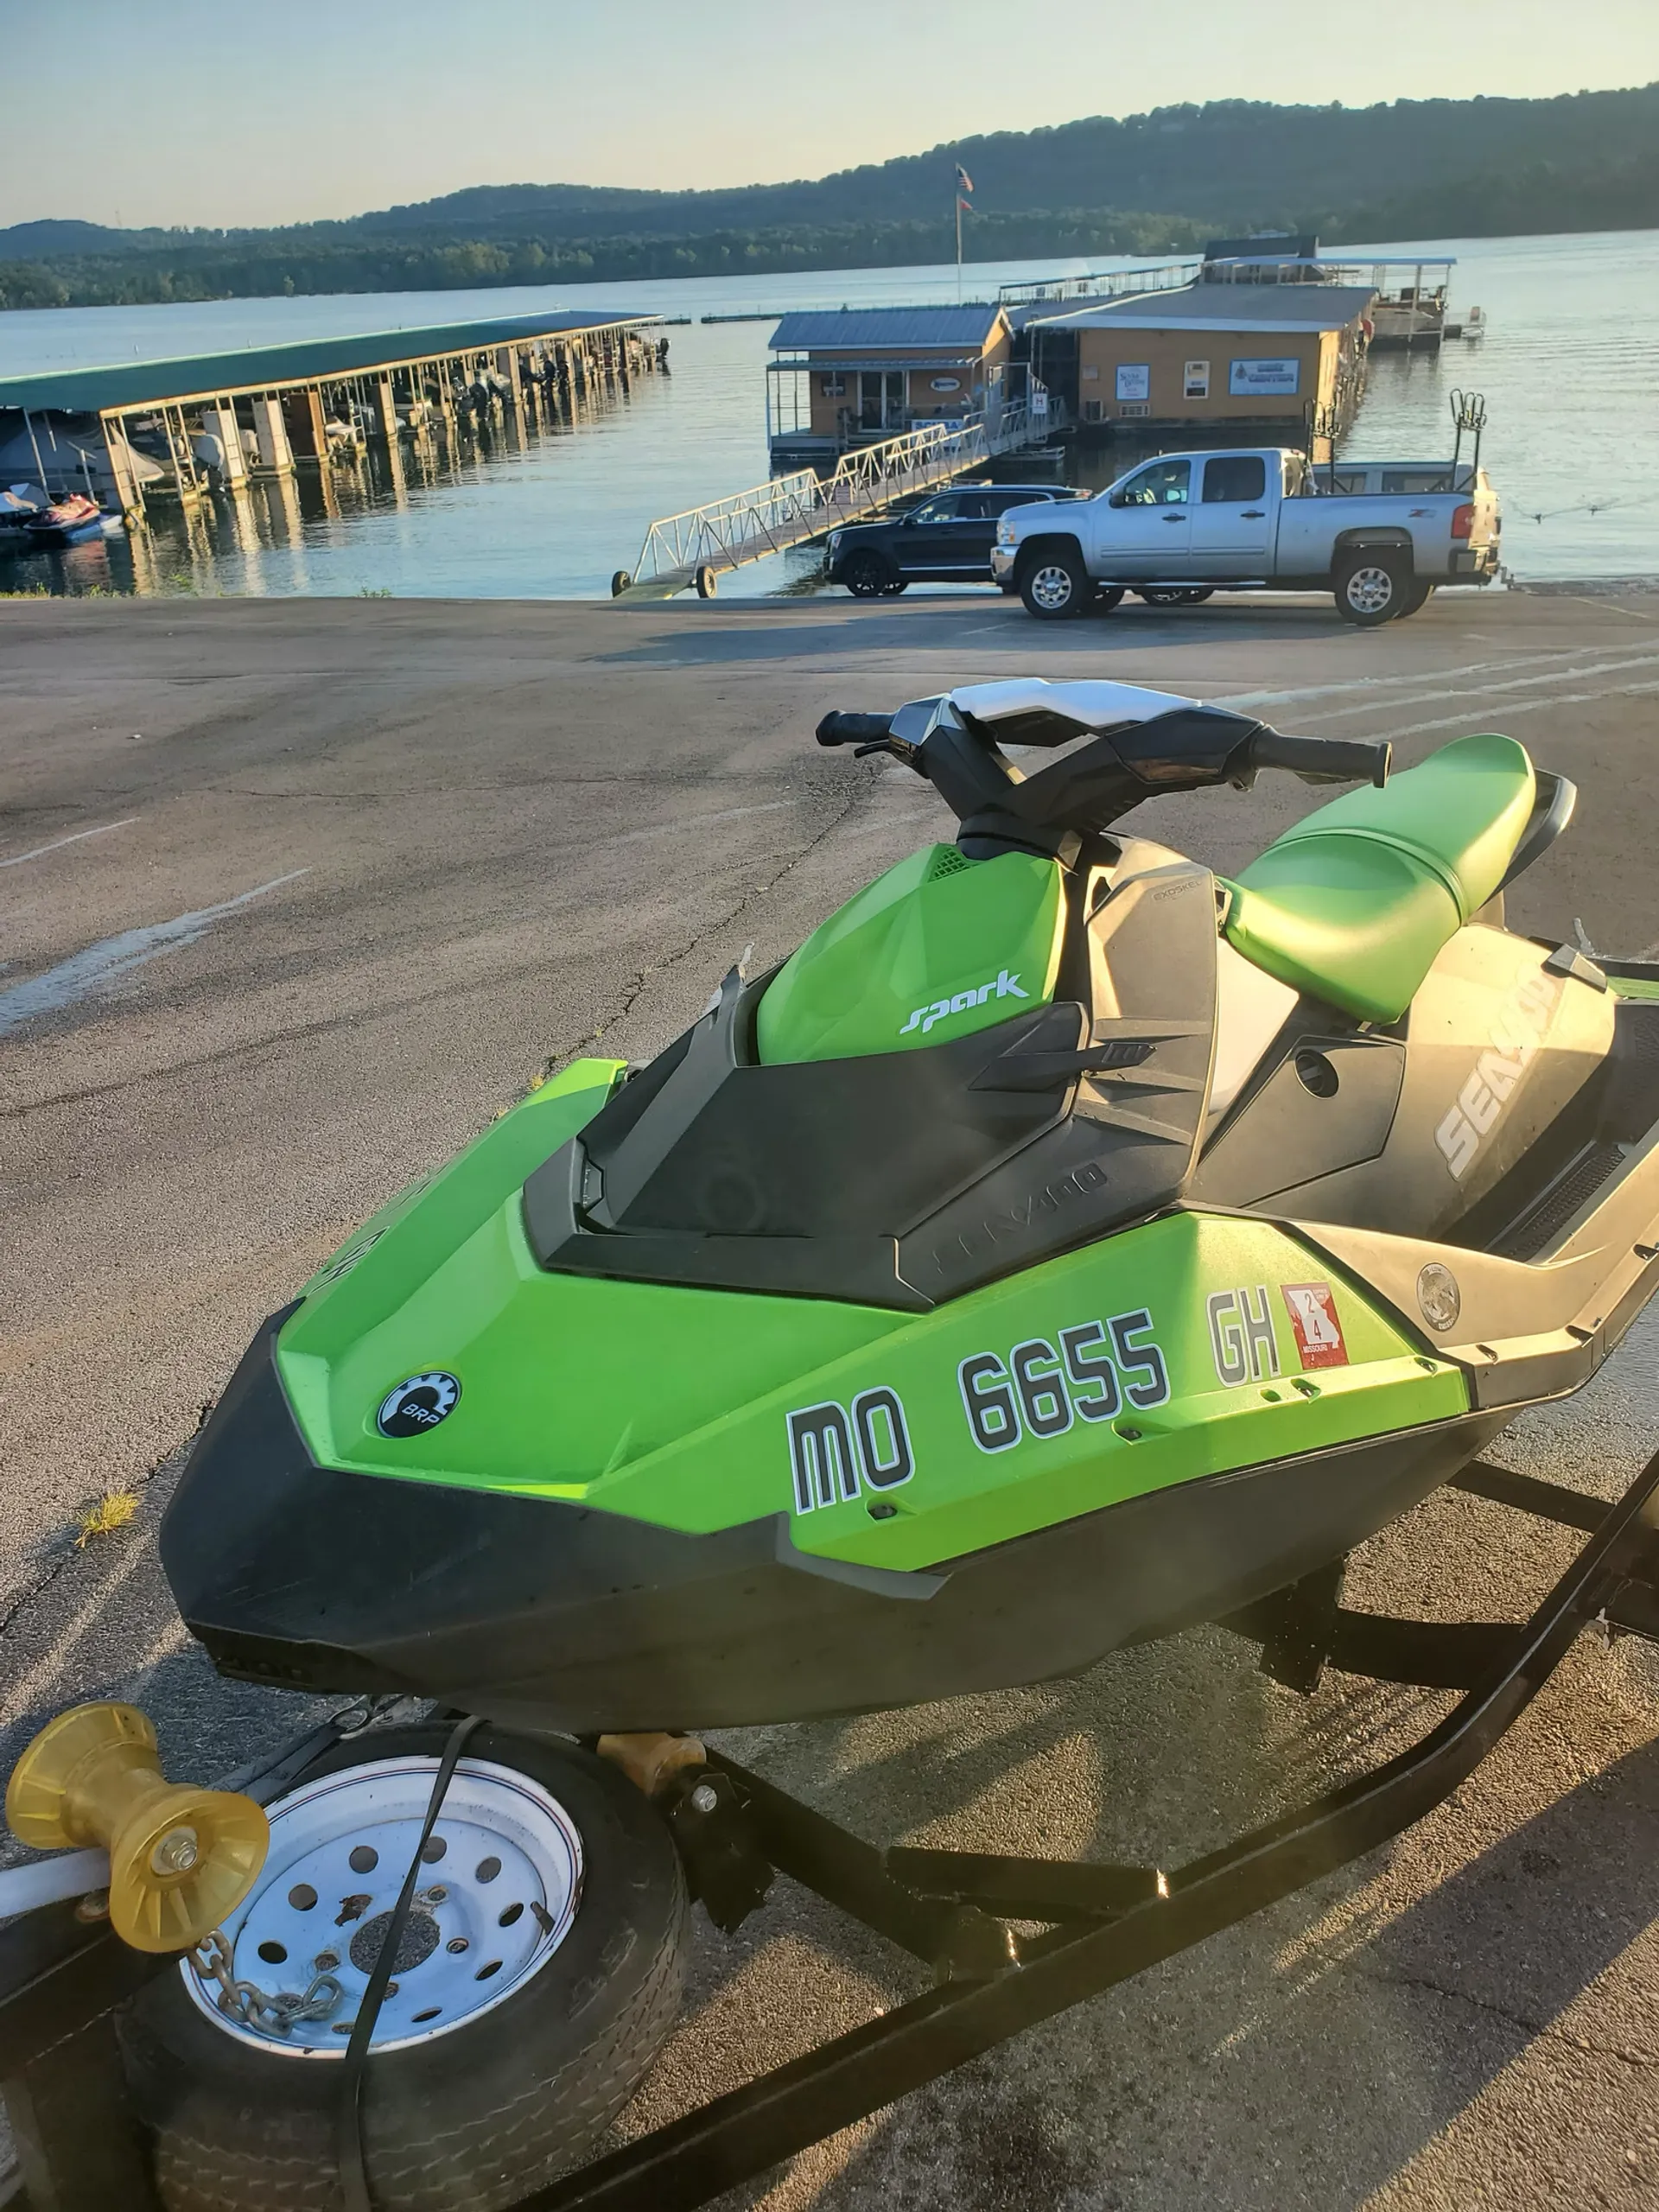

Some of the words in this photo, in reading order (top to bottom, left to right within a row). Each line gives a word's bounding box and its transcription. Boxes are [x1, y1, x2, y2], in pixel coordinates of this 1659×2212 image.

[1304, 1293, 1315, 1313] 2
[1313, 1319, 1322, 1340] 4
[1303, 1344, 1329, 1354] MISSOURI
[786, 1385, 917, 1516] MO
[957, 1307, 1172, 1454] 6655
[1206, 1283, 1282, 1388] GH
[401, 1402, 441, 1424] BRP
